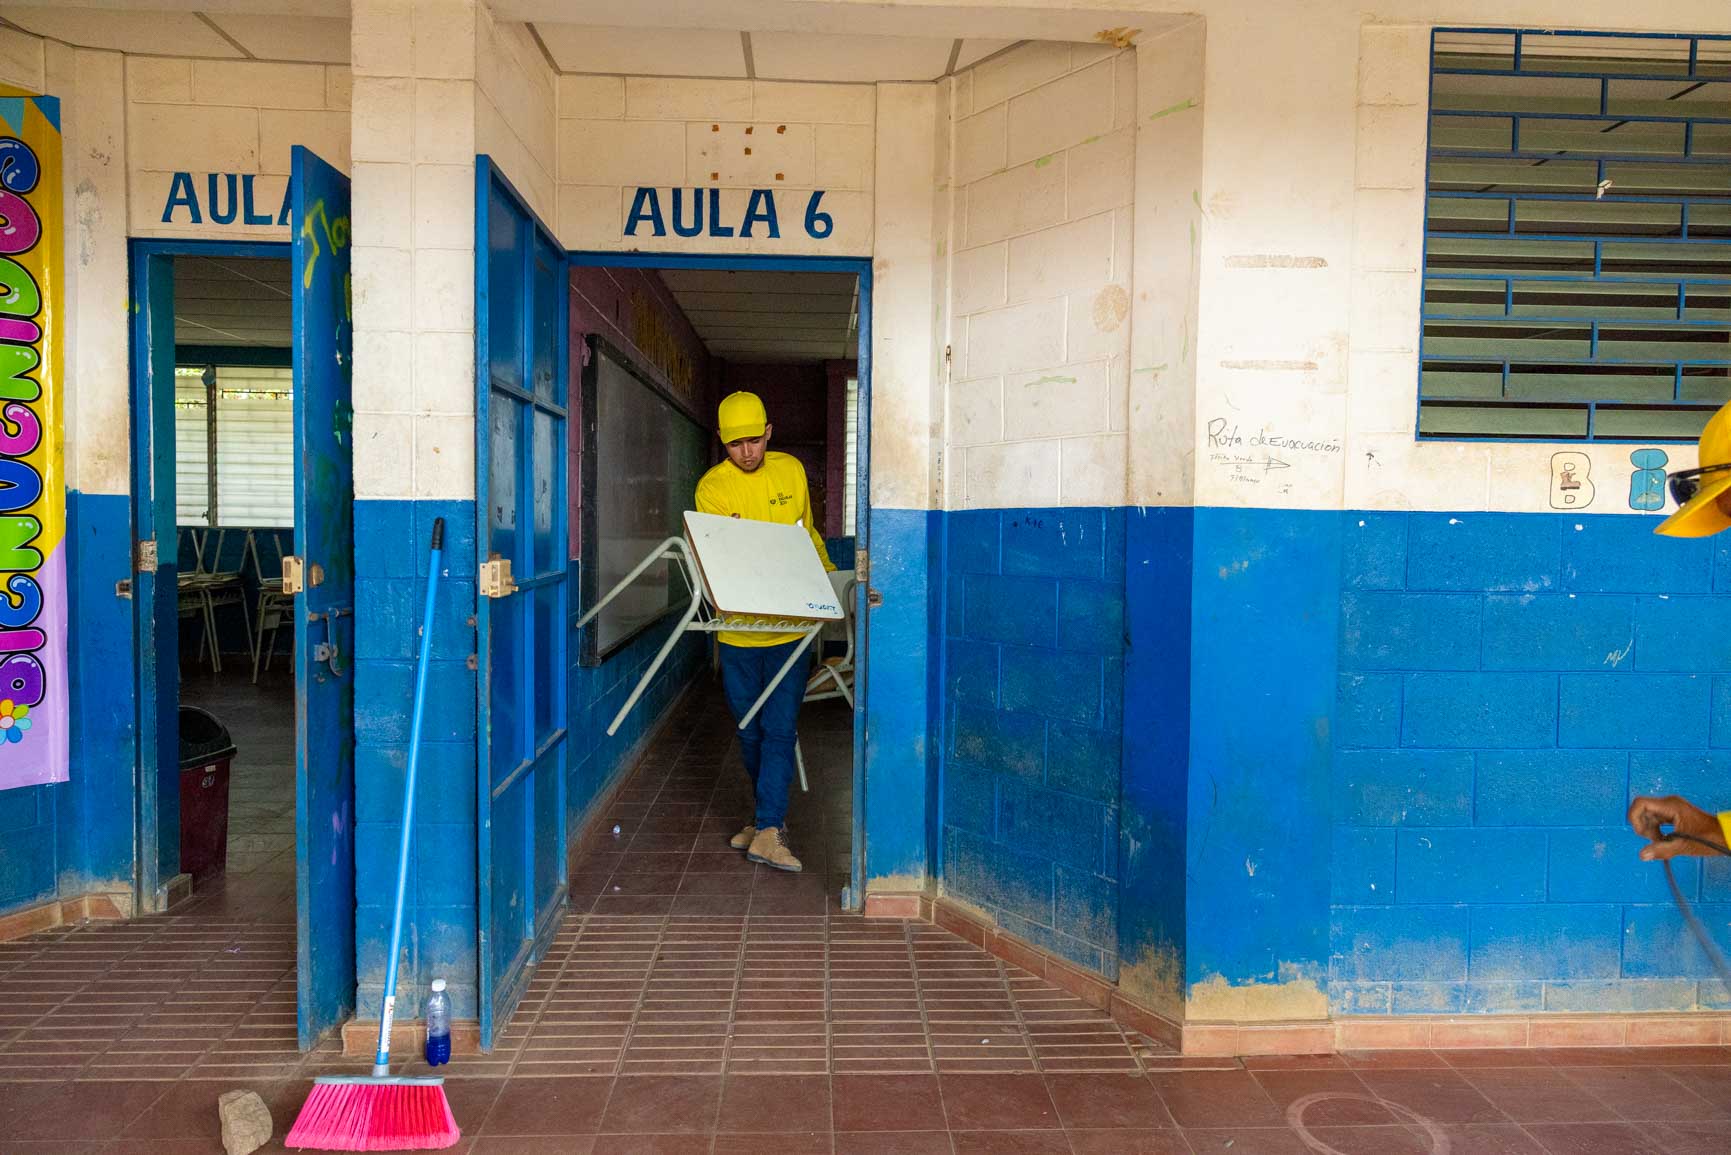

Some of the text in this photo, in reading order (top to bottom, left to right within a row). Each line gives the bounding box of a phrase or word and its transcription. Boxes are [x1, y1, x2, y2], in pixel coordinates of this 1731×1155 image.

[624, 187, 834, 239] AULA 6
[1208, 417, 1242, 448] Ruta
[1249, 428, 1268, 447] de
